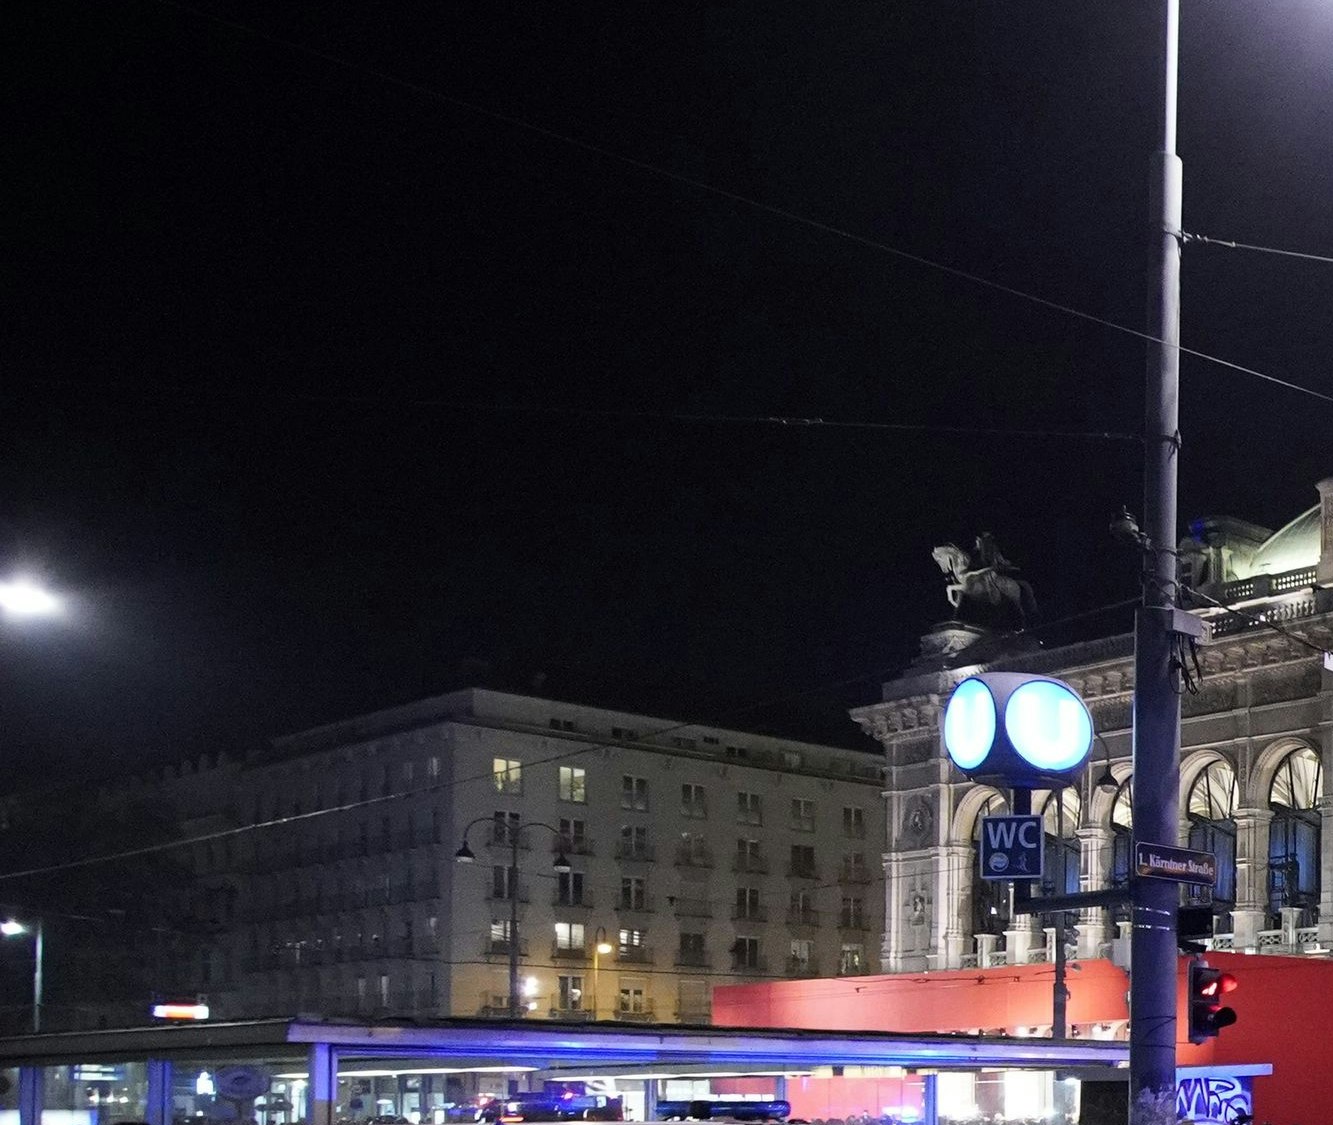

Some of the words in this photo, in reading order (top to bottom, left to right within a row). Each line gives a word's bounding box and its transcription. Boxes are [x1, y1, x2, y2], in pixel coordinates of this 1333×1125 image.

[1019, 692, 1080, 763] U
[986, 821, 1038, 849] WC
[1188, 859, 1214, 876] Straße
